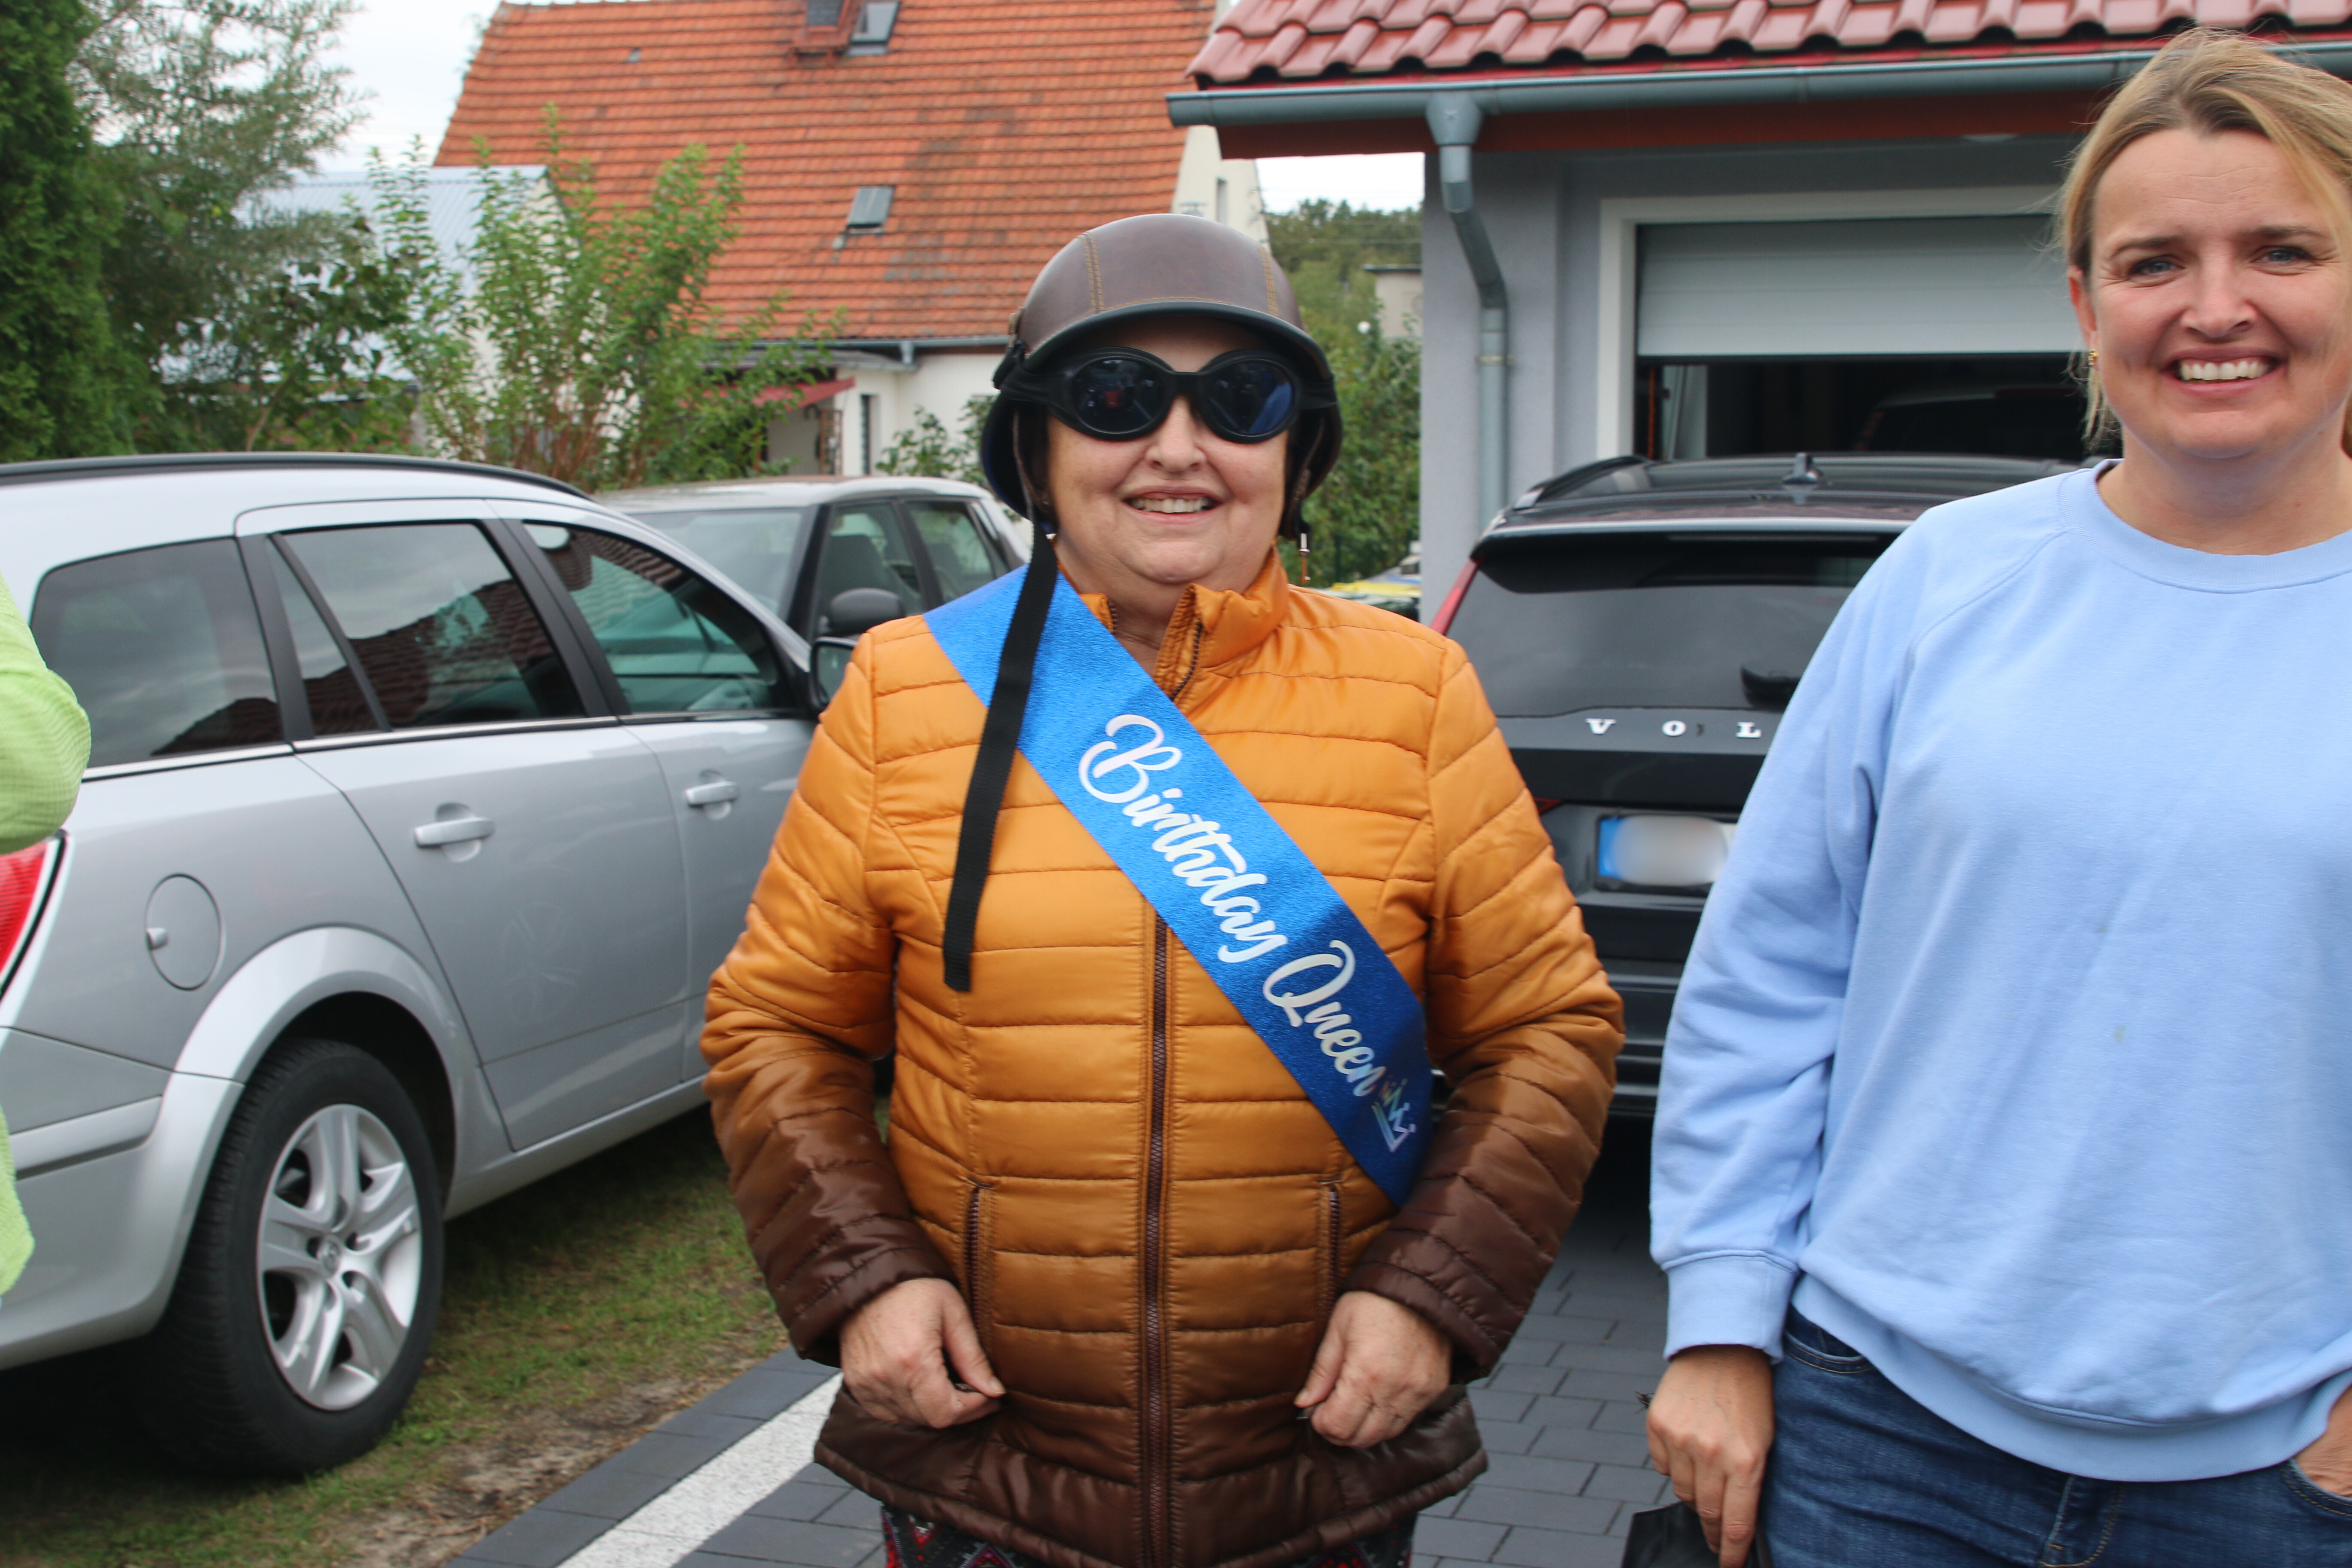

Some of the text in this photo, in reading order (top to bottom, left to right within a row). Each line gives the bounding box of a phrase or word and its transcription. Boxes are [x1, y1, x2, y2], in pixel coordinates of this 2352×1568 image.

[1586, 718, 1761, 738] VOL
[1078, 714, 1387, 1097] Birthday Queen
